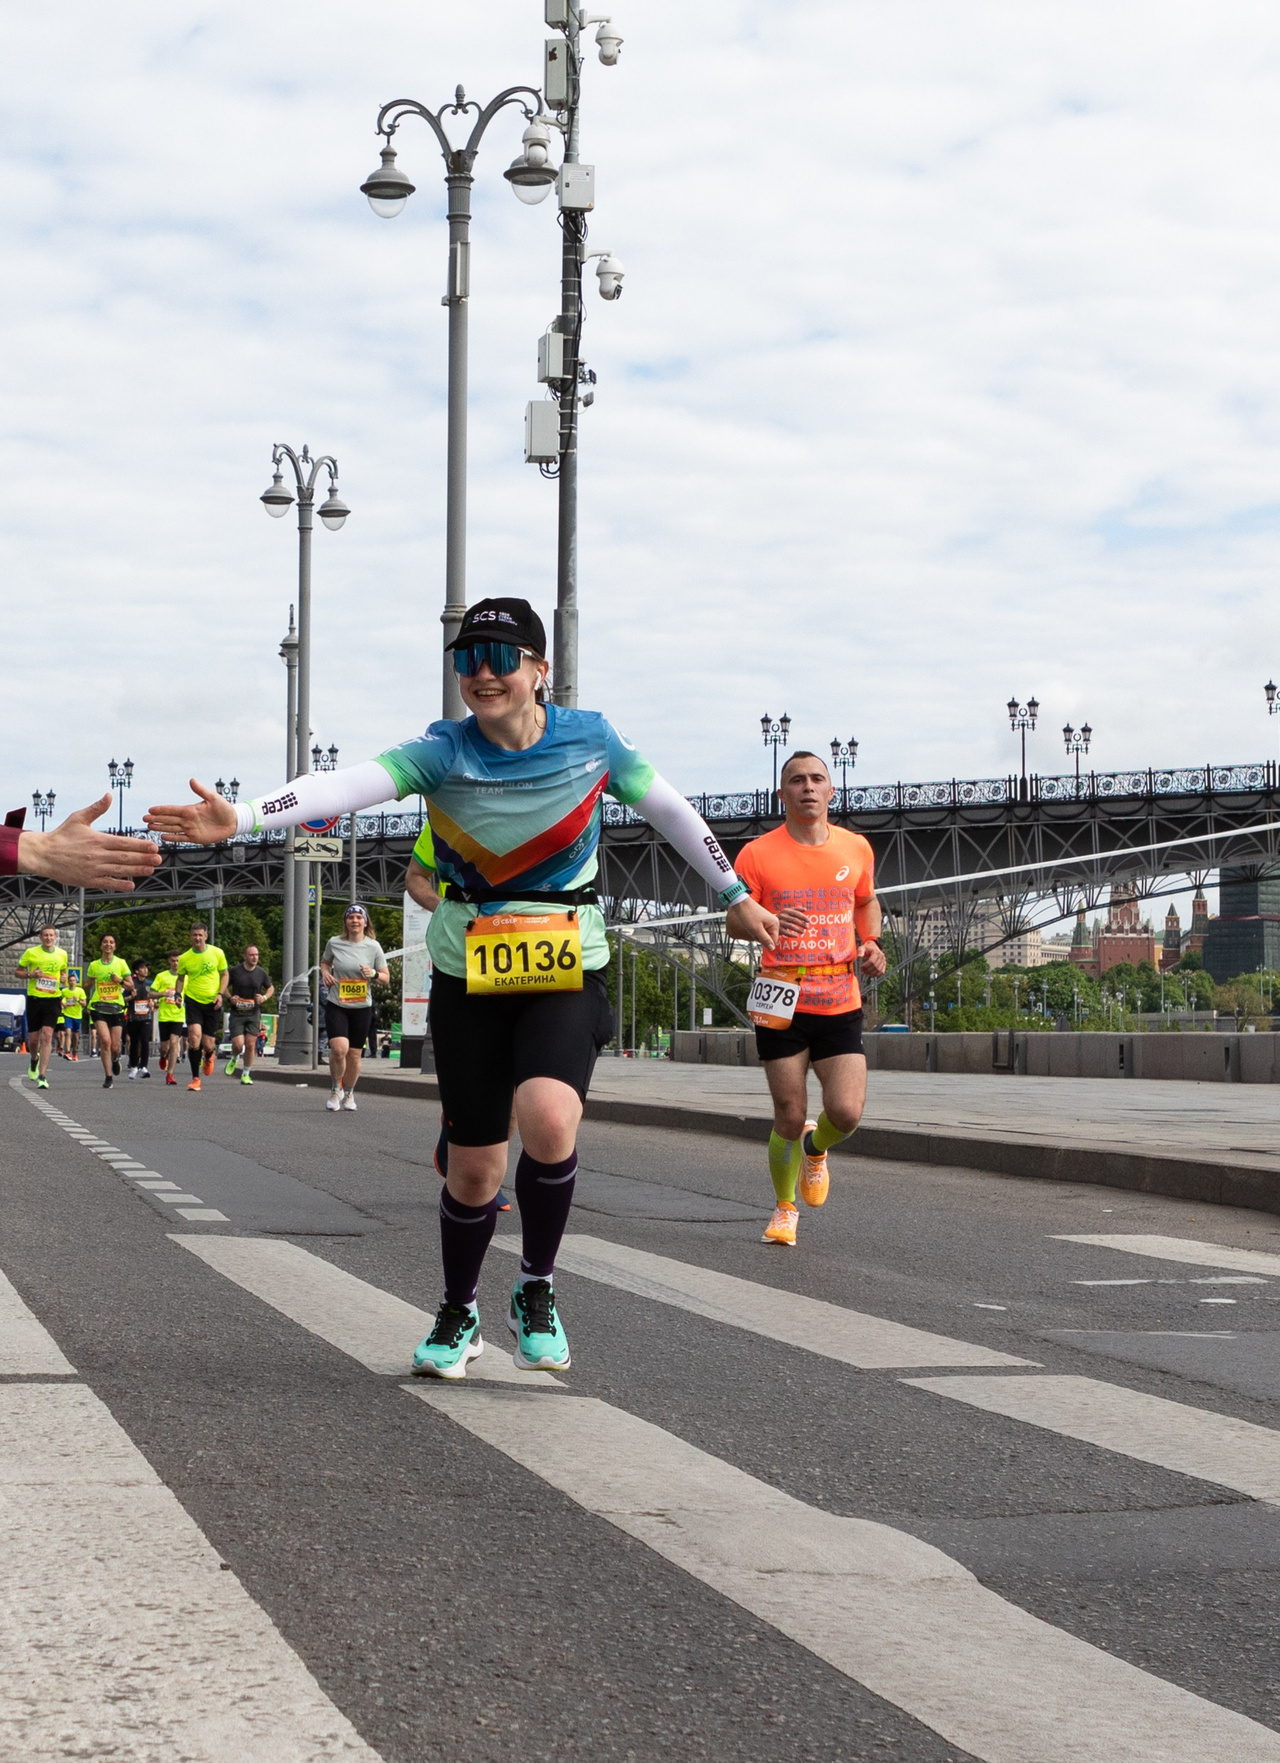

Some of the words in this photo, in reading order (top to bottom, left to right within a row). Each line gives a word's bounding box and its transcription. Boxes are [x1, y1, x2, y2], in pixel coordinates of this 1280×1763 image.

[472, 611, 496, 624] SCS
[474, 939, 577, 975] 10136
[494, 974, 556, 986] ЕКАТЕРИНА
[341, 984, 366, 993] 10681
[750, 982, 796, 1007] 10378
